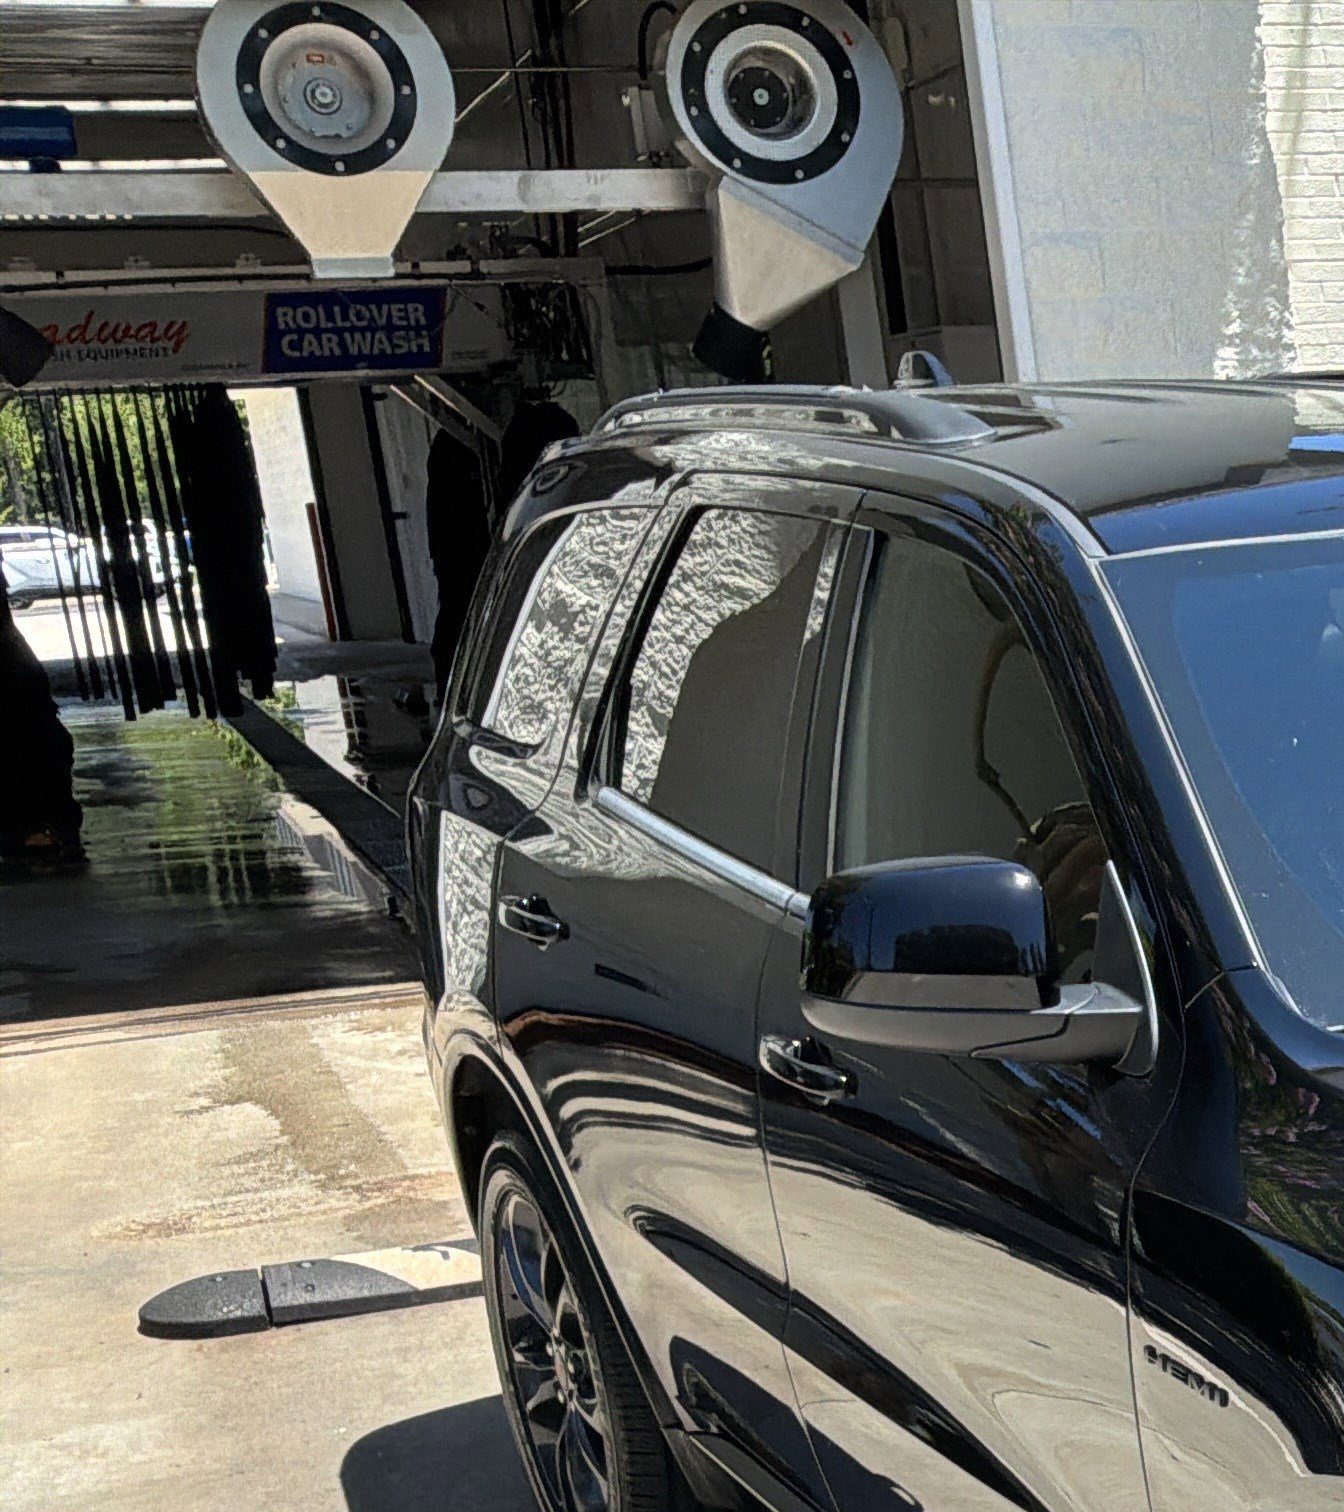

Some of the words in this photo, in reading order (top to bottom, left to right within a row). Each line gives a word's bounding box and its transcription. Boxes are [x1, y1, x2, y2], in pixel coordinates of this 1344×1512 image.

[276, 303, 427, 330] ROLLOVER
[40, 310, 189, 355] adway
[281, 333, 342, 357] CAR
[343, 330, 431, 355] WASH
